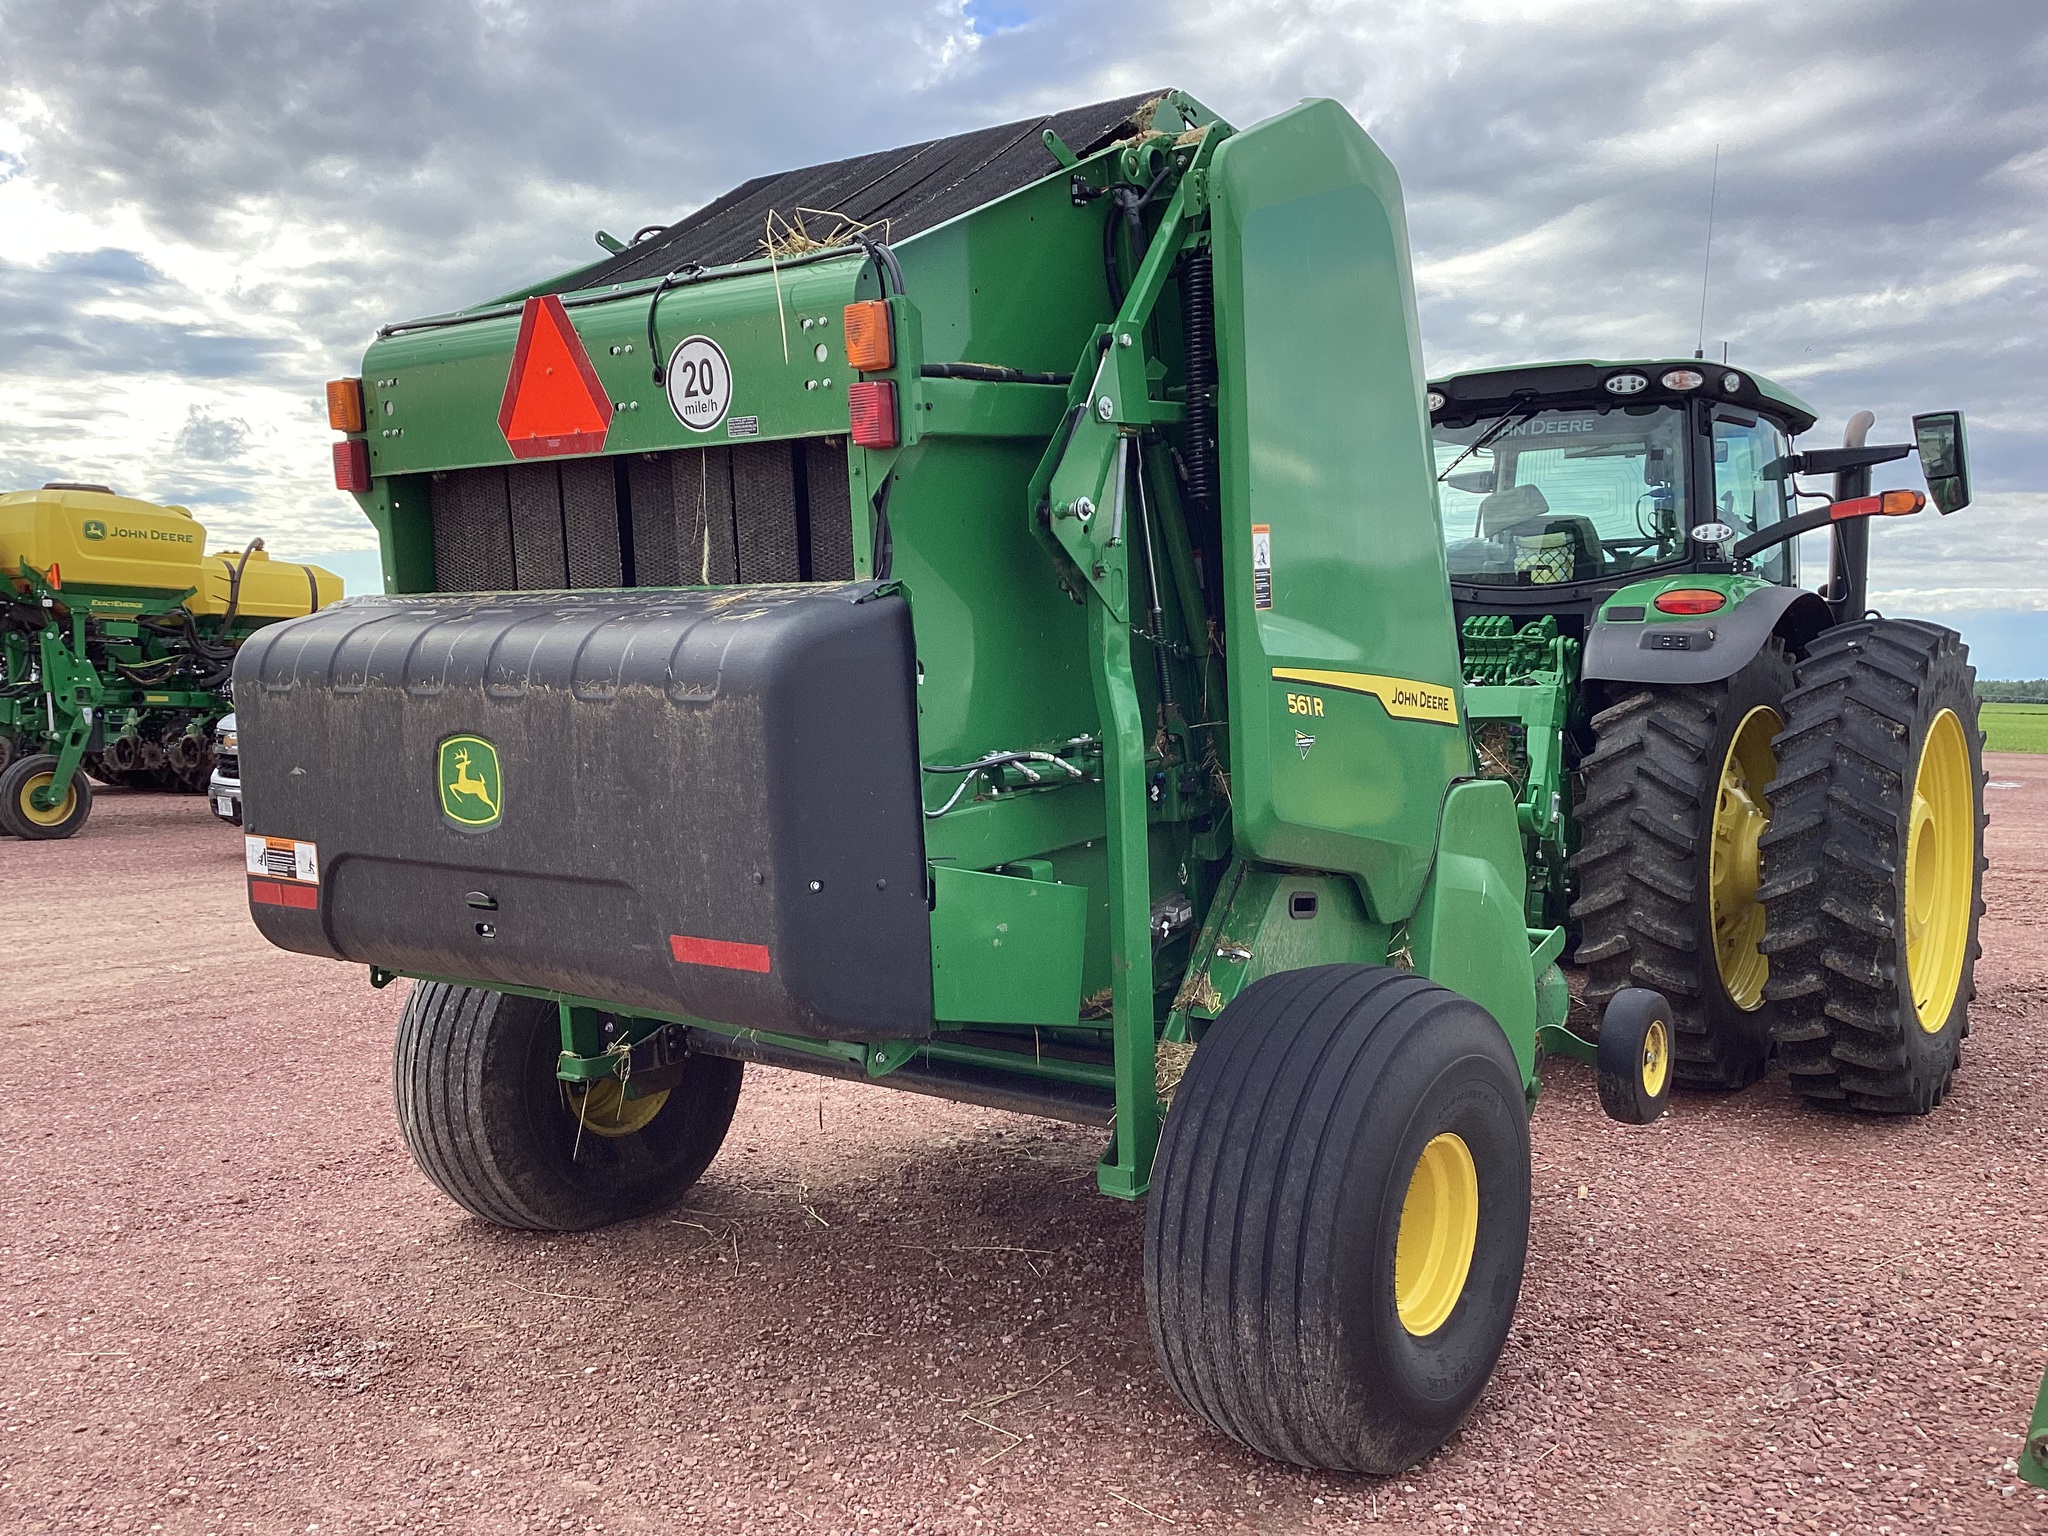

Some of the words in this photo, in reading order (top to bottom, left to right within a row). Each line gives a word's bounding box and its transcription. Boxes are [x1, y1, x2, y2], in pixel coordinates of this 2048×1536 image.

[682, 358, 714, 398] 20
[685, 399, 718, 415] mile/h
[1476, 423, 1527, 438] JHN
[1531, 419, 1594, 435] DEERE
[110, 527, 148, 539] JOHN
[150, 529, 194, 543] DEERE
[1391, 686, 1418, 707] JOHN
[1419, 690, 1449, 711] DEERE
